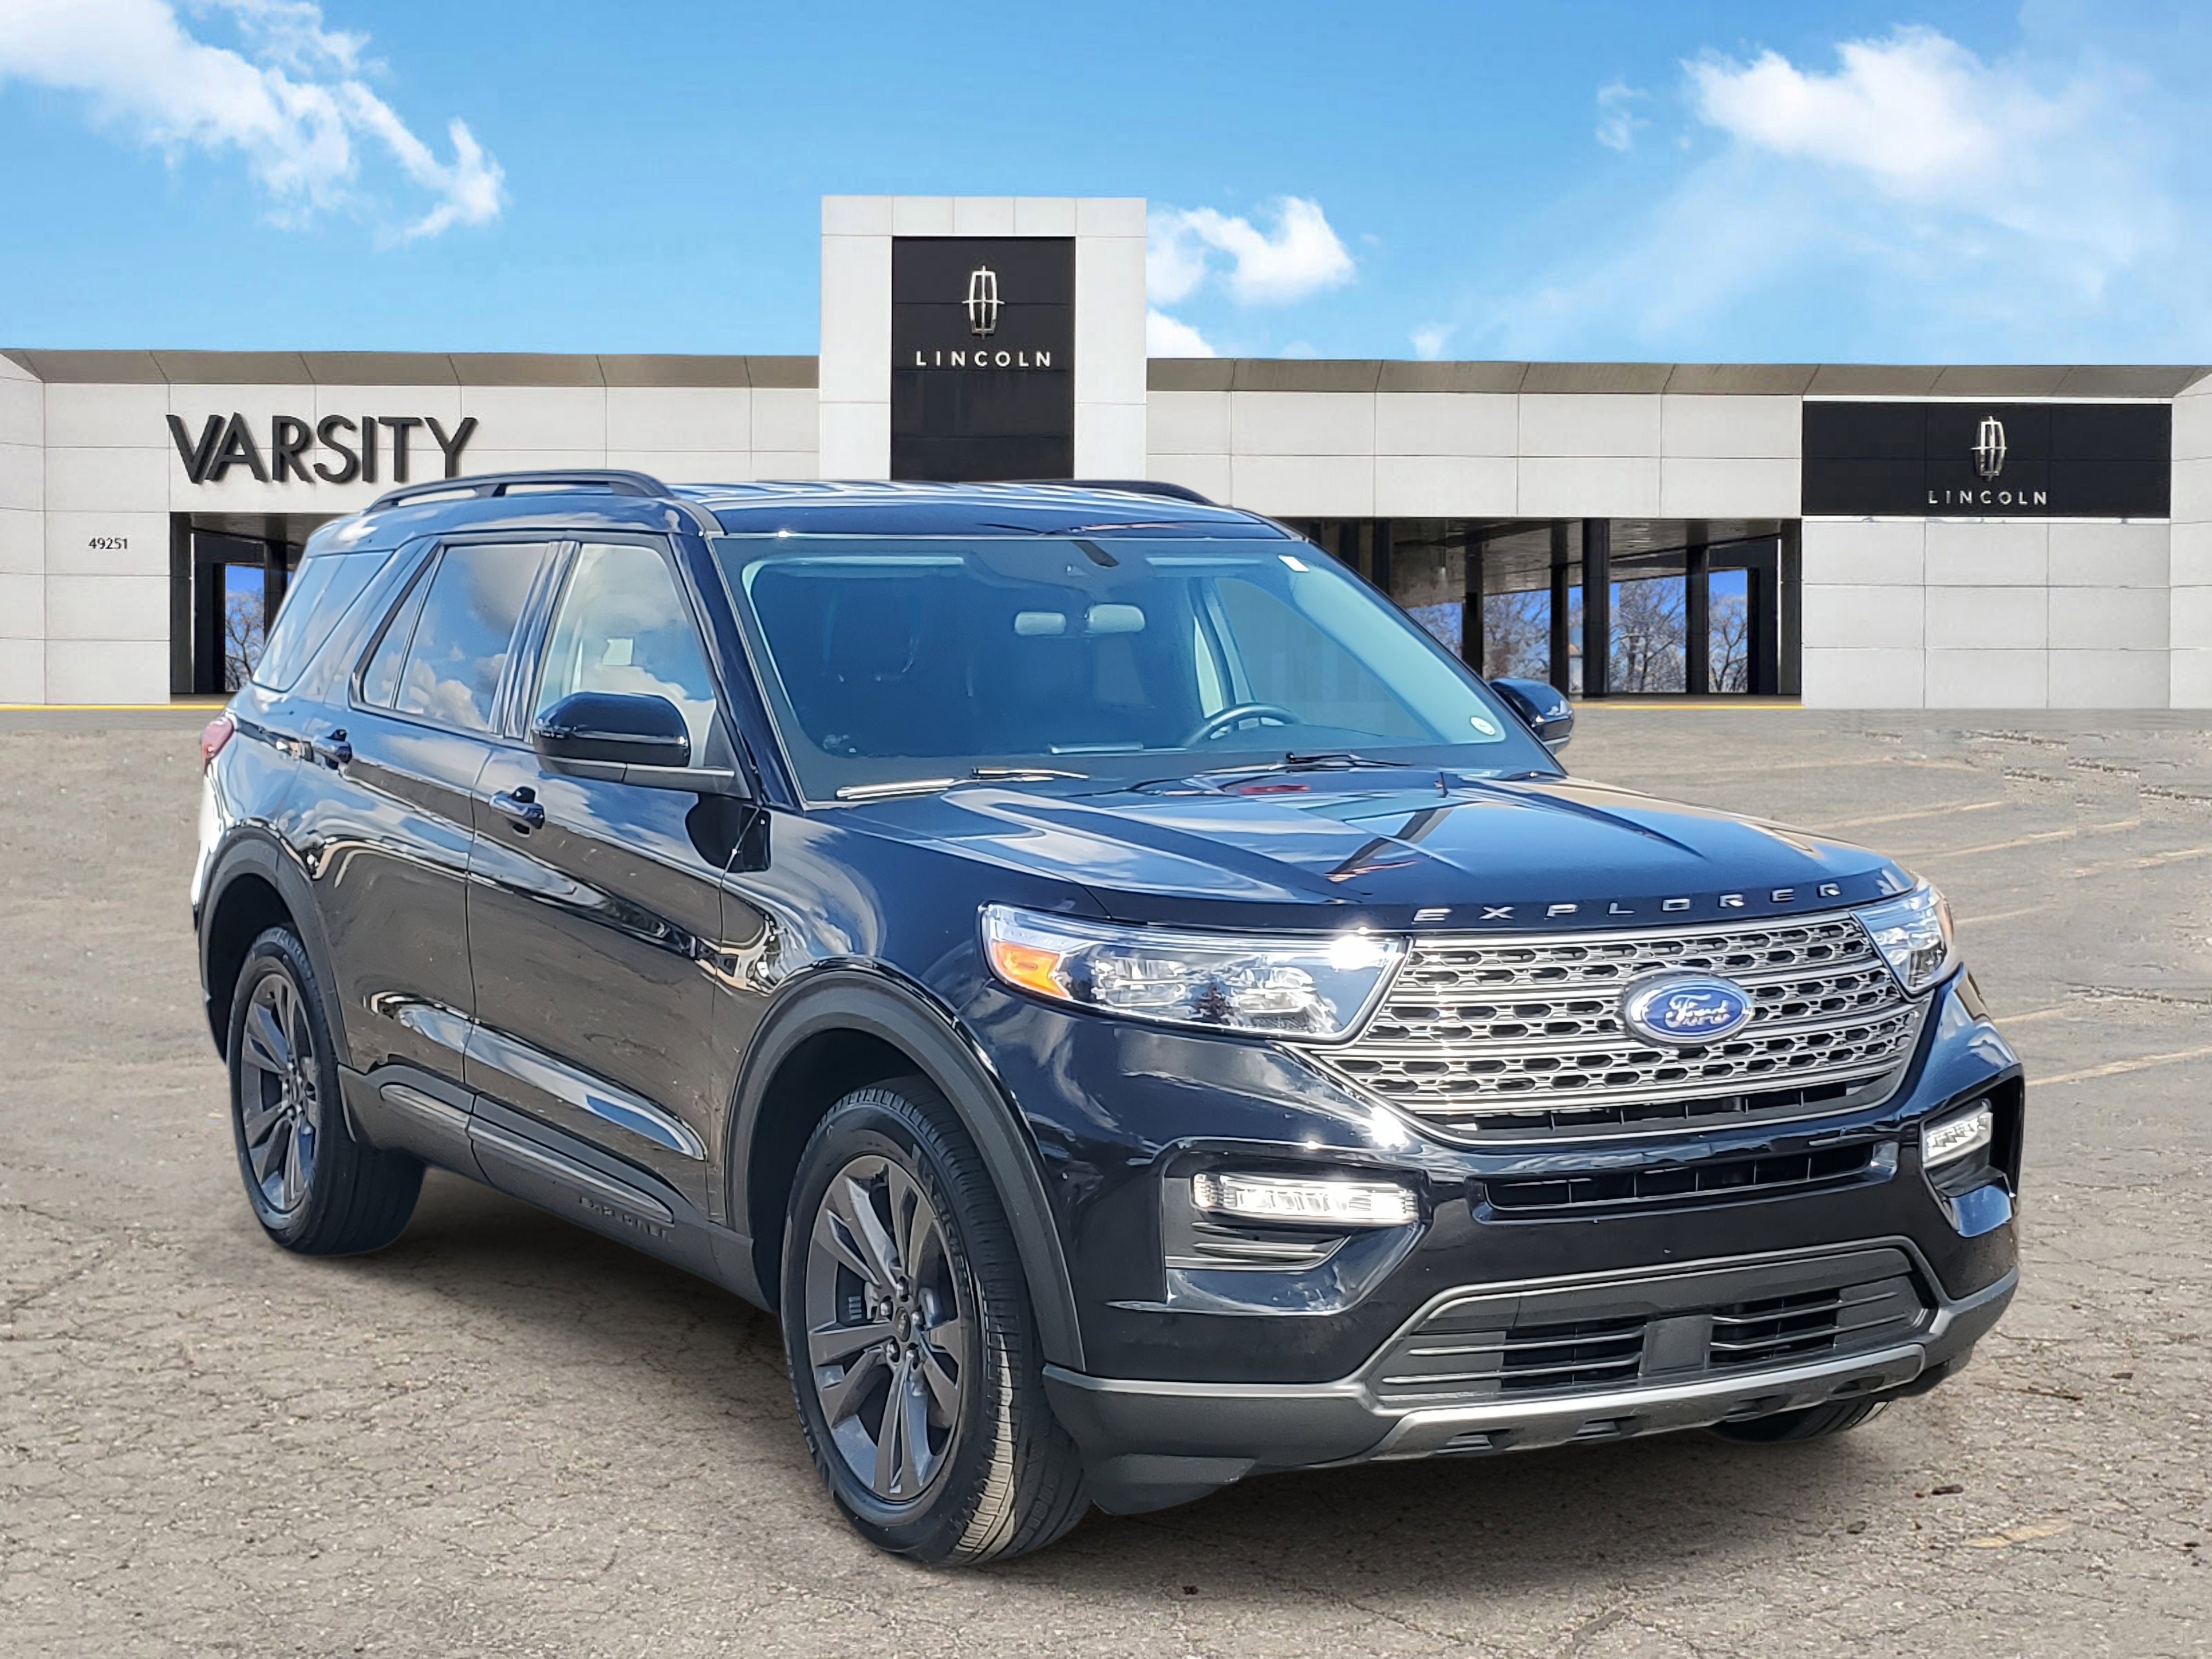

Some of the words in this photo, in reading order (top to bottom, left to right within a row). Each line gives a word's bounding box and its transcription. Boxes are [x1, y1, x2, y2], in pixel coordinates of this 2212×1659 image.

[916, 350, 1051, 367] LINCOLN
[166, 412, 478, 484] VARSITY
[1928, 490, 2048, 506] LINCOLN
[88, 537, 128, 549] 49251
[1411, 882, 1842, 924] EXPLORER
[1665, 994, 1730, 1028] Ford
